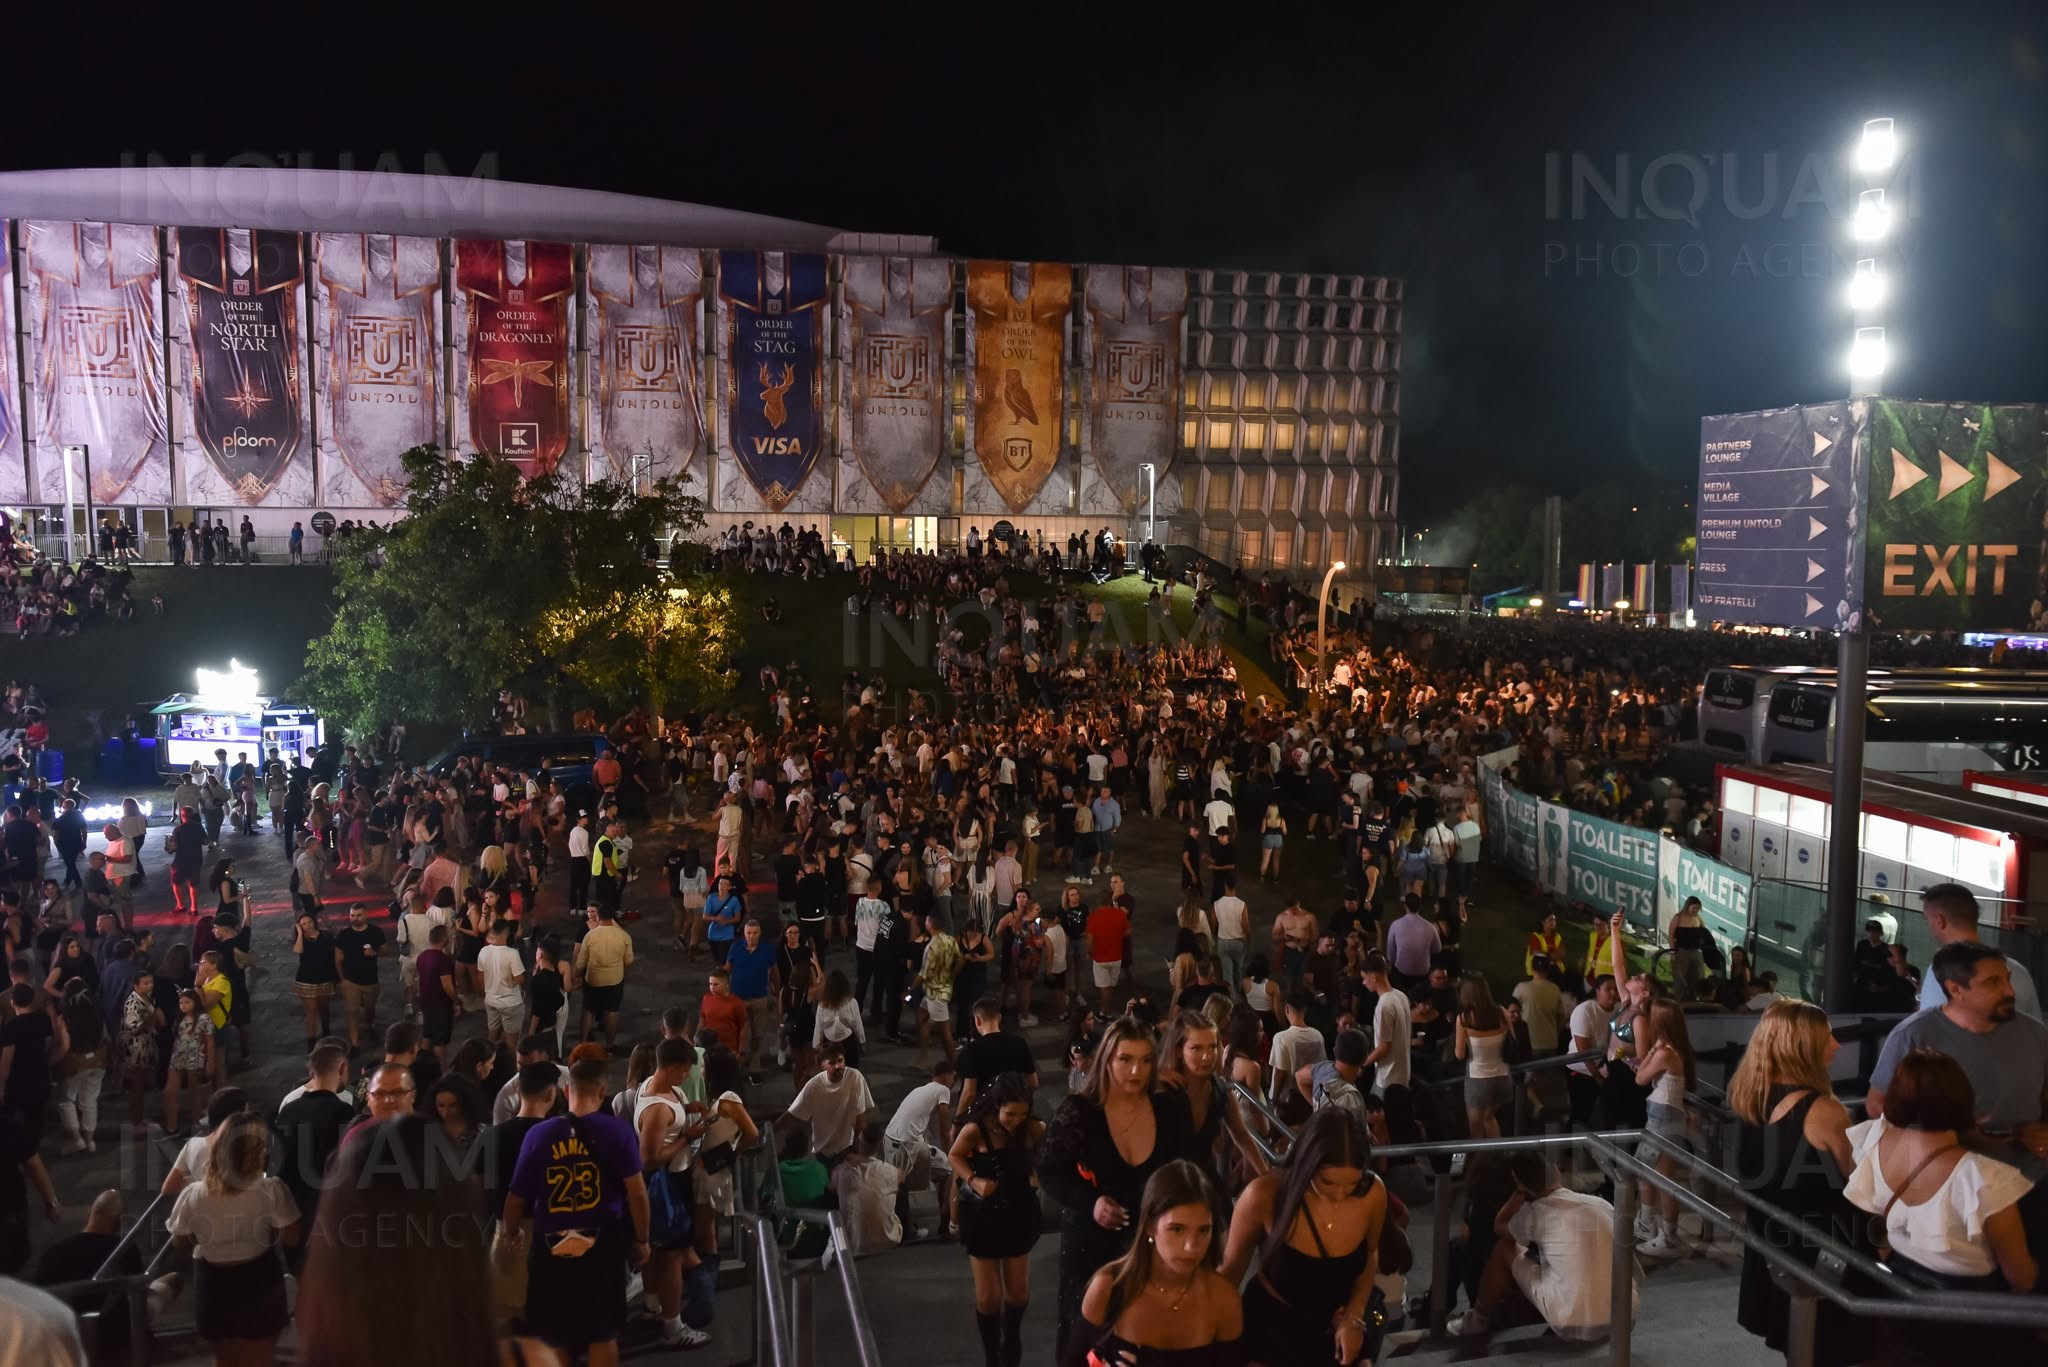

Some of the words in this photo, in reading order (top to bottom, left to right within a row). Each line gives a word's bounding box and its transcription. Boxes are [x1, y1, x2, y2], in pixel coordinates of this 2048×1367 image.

[221, 301, 263, 311] ORDER
[496, 311, 537, 321] ORDER
[502, 322, 511, 330] OF
[755, 320, 793, 329] ORDER
[210, 323, 277, 338] NORTH
[773, 331, 787, 339] THE
[1001, 328, 1037, 337] ORDER
[479, 331, 554, 344] DRAGONFLY
[221, 337, 268, 351] STAR
[754, 340, 796, 354] STAG
[1001, 348, 1038, 361] OWL
[349, 392, 418, 404] UNTOLD
[616, 399, 682, 410] UNTOLD
[866, 406, 928, 417] UNTOLD
[1105, 411, 1164, 421] UNTOLD
[223, 426, 276, 458] ploom
[752, 436, 802, 455] VISA
[1706, 440, 1752, 451] PARTNERS
[1009, 446, 1027, 457] BT
[1705, 452, 1741, 463] LOUNGE
[1704, 482, 1731, 491] MEDIA
[1703, 493, 1740, 502] VILLAGE
[1702, 519, 1741, 528] PREMIUM
[1743, 518, 1782, 528] UNTOLD
[1701, 530, 1737, 540] LOUNGE
[1699, 562, 1727, 572] PRESS
[1883, 544, 2018, 596] EXIT
[1699, 594, 1713, 604] VIP
[1714, 596, 1756, 608] FRATELLI
[1572, 820, 1656, 867] TOALETE
[1571, 864, 1654, 917] TOILETS
[1681, 859, 1747, 915] TOALETE
[547, 1162, 600, 1213] 23
